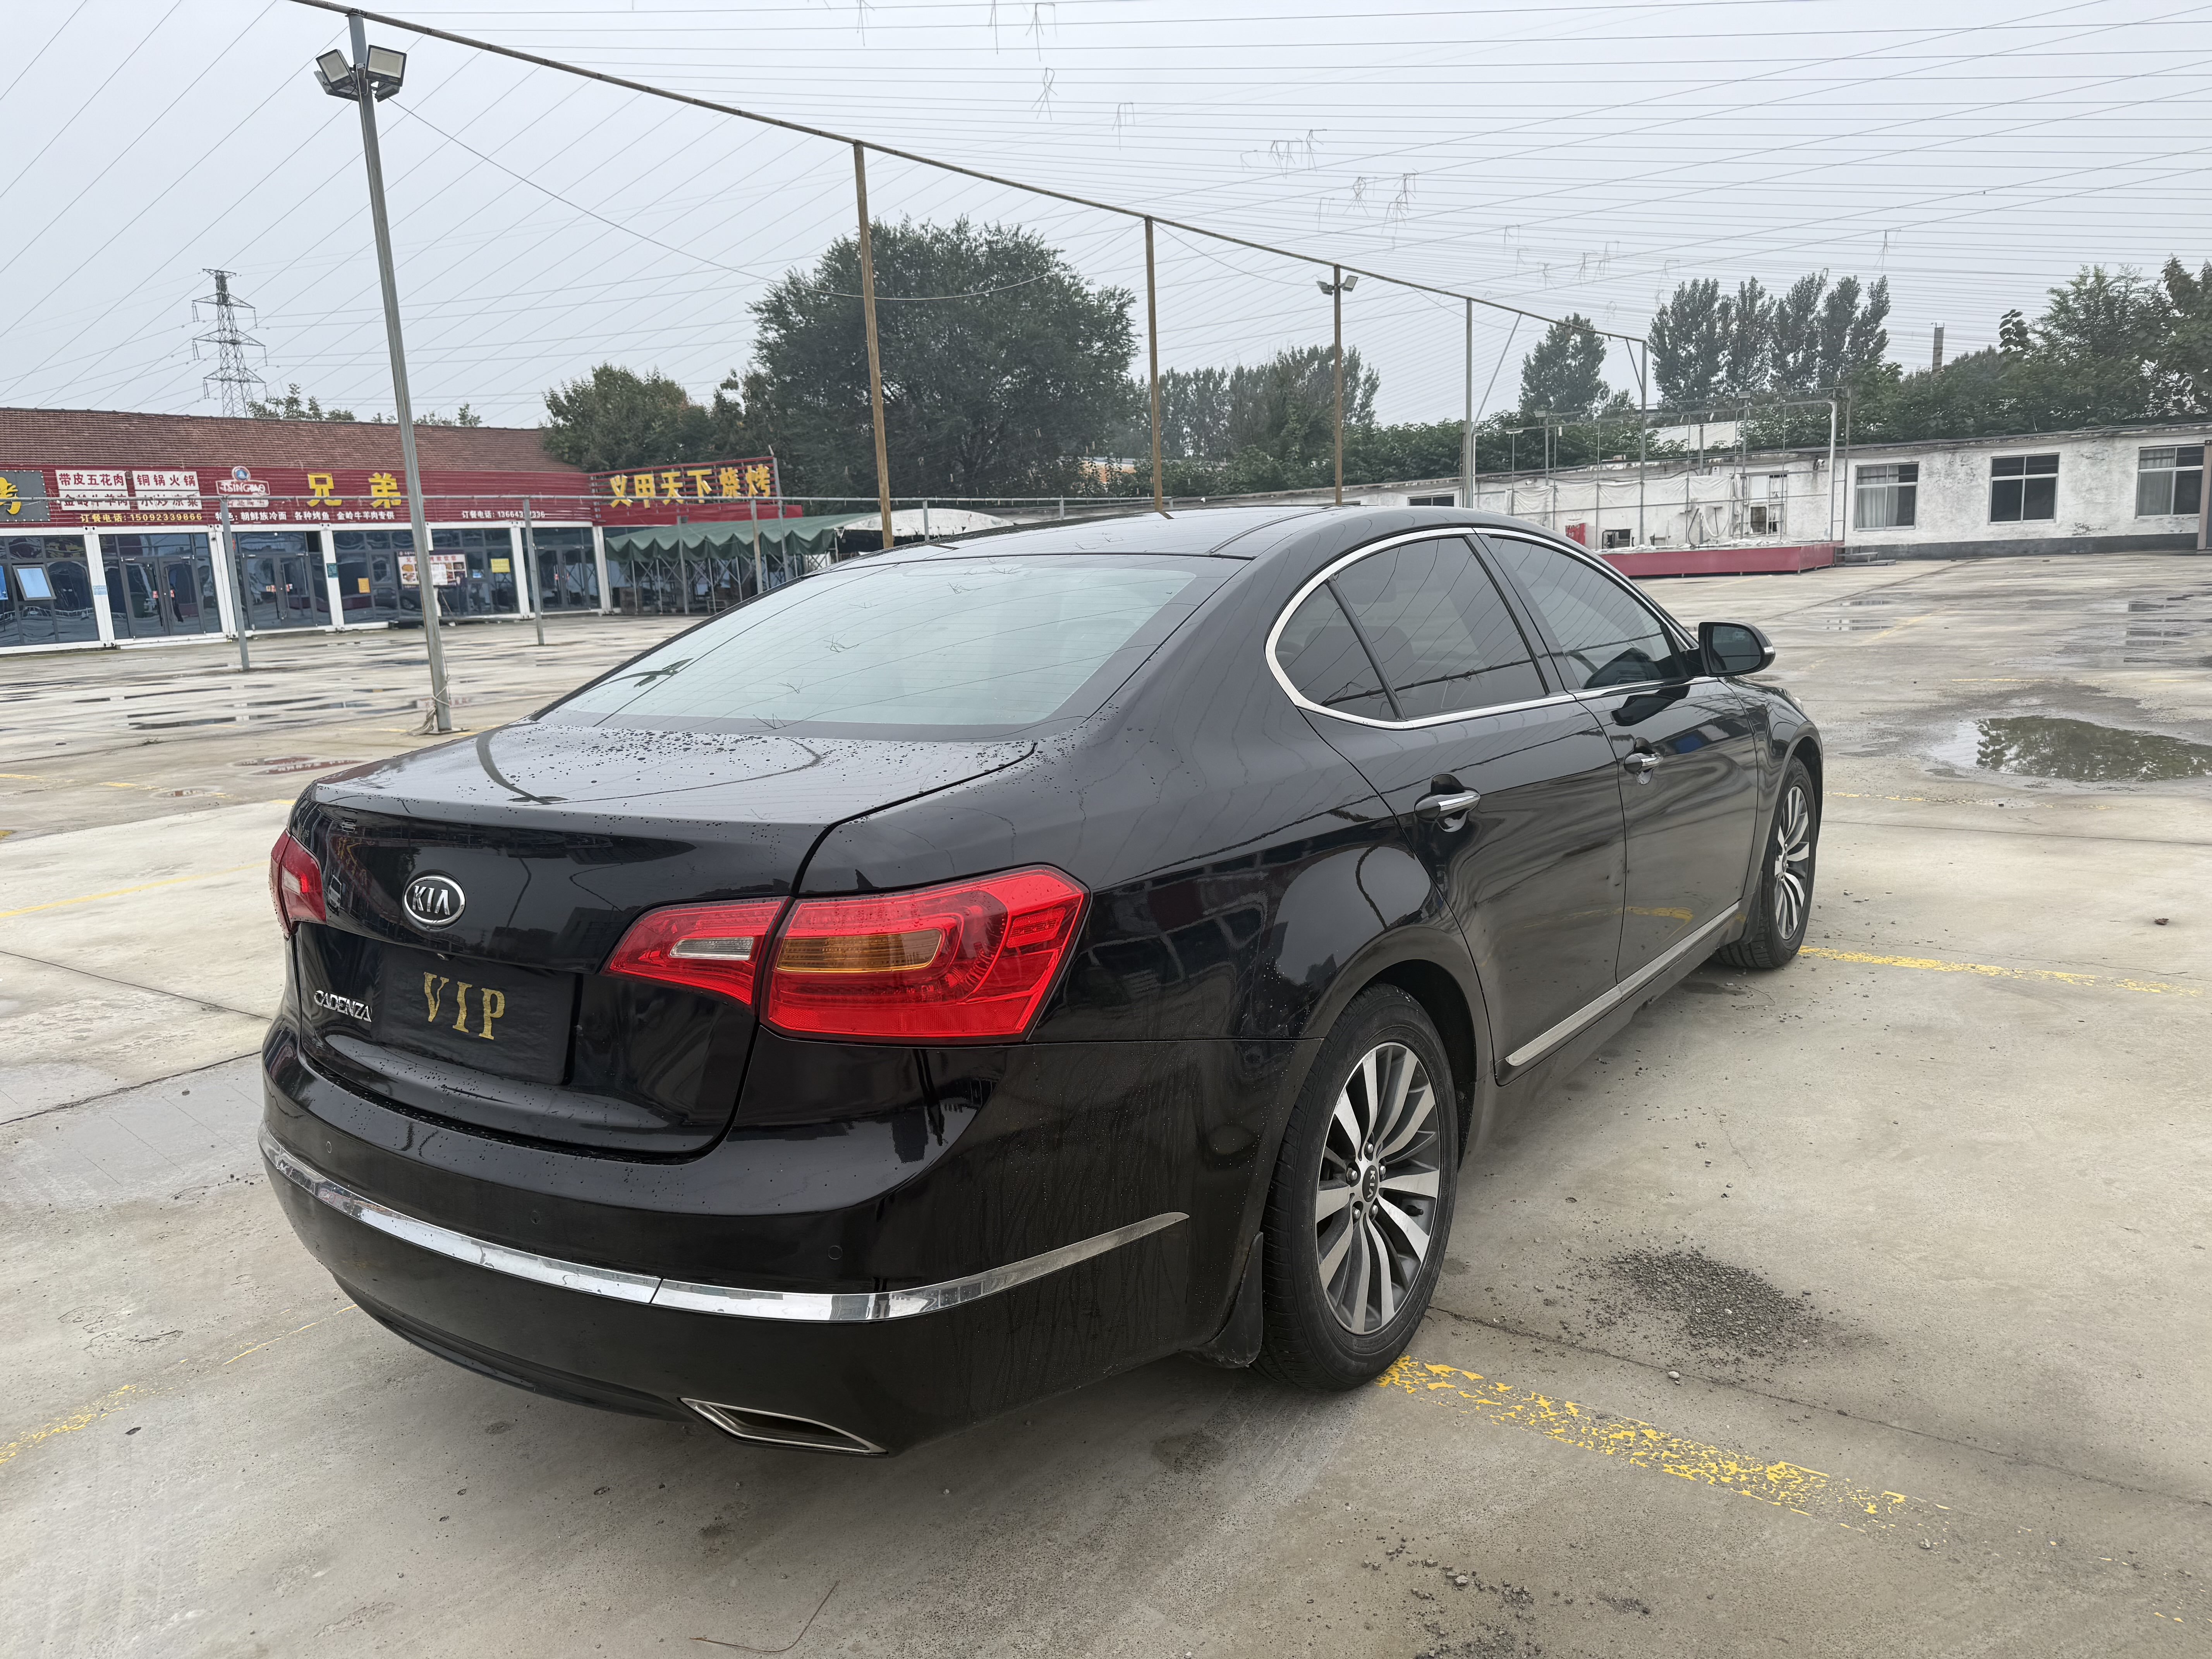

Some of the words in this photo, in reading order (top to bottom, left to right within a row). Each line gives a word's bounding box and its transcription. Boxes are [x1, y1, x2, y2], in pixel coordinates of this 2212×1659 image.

[59, 473, 125, 486] 带皮五花肉
[137, 474, 196, 486] 铜锅火锅
[307, 472, 402, 509] 兄弟
[295, 511, 330, 520] 各种烤鱼
[337, 510, 395, 520] 金岭牛羊肉专供
[412, 885, 450, 915] KIA
[314, 990, 372, 1022] CADENZA
[424, 972, 505, 1040] VIP
[1367, 1170, 1376, 1199] KIA
